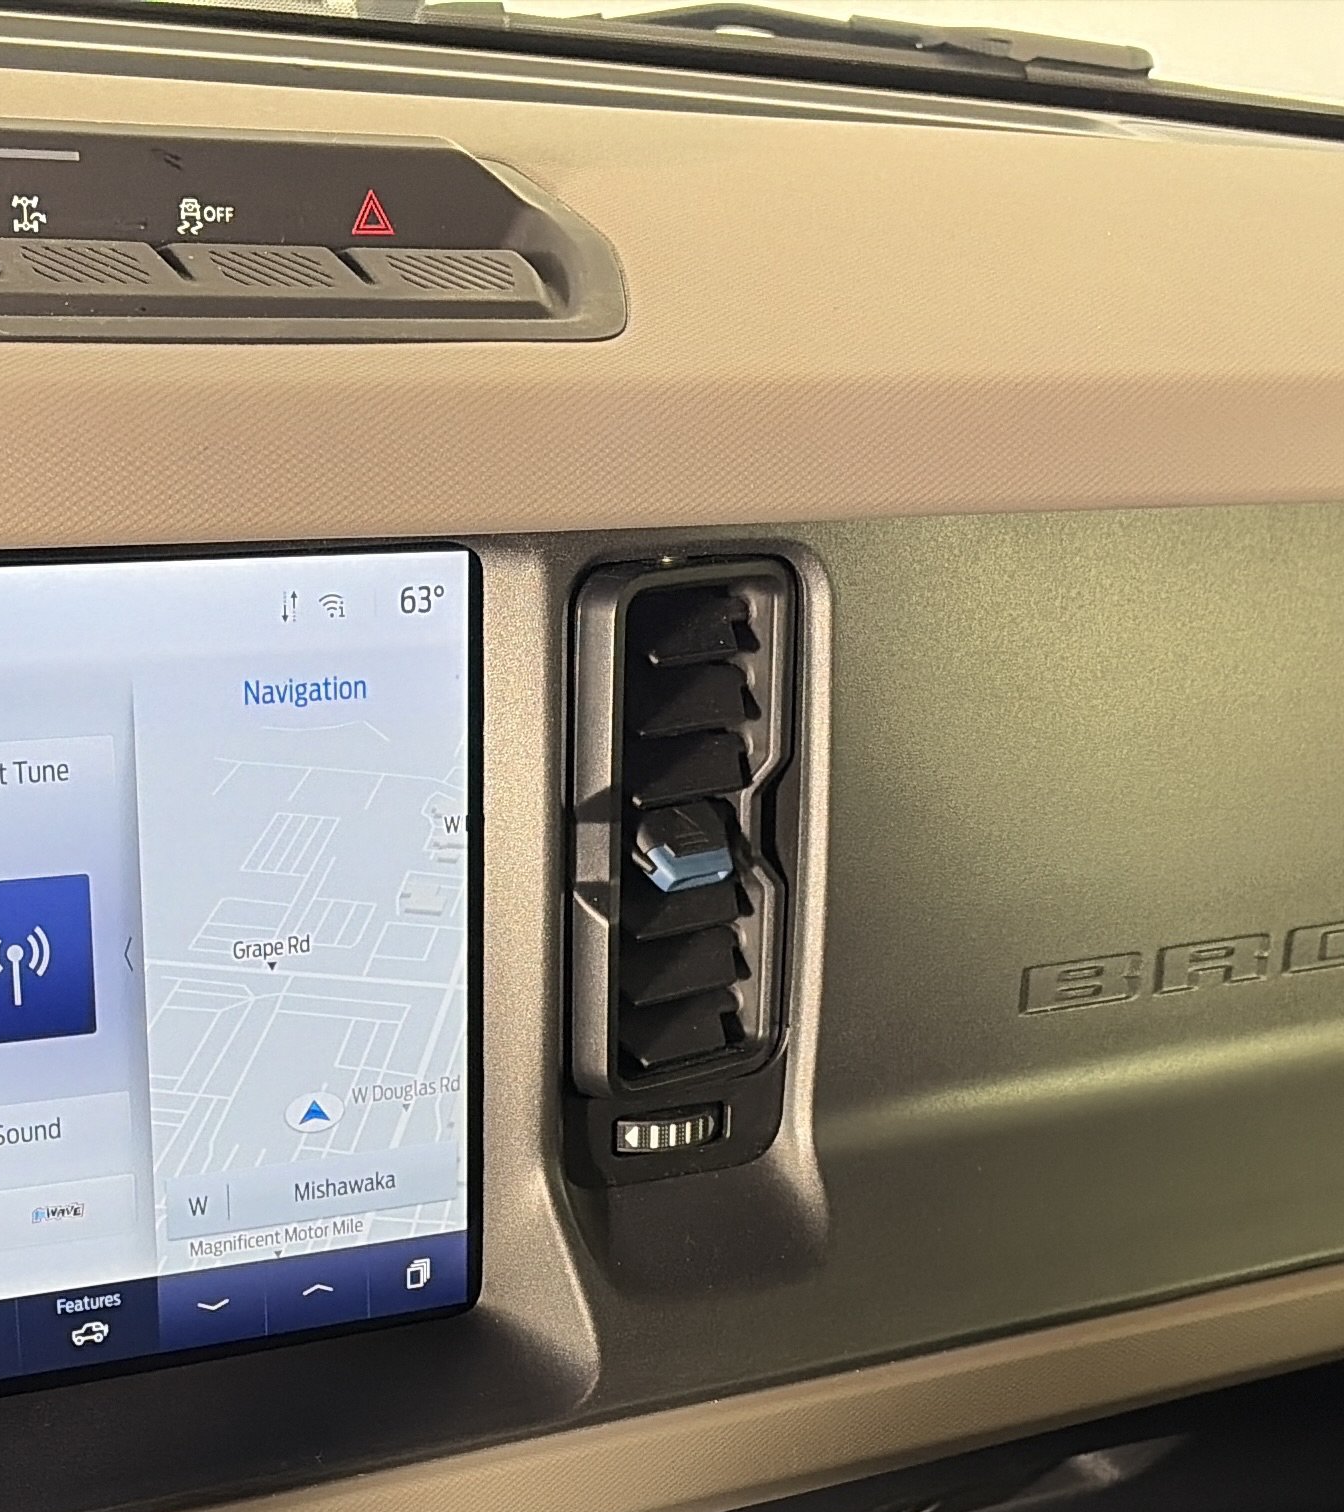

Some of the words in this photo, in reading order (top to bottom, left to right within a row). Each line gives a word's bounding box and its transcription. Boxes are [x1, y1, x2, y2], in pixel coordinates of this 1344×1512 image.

[204, 204, 235, 223] OFF
[400, 585, 446, 615] 63°
[243, 675, 368, 708] Navigation
[13, 757, 70, 786] Tune
[233, 936, 283, 961] Grape
[287, 934, 311, 956] Rd
[353, 1086, 369, 1103] W
[372, 1079, 436, 1107] Douglas
[438, 1074, 461, 1095] Rd
[294, 1171, 397, 1203] Mishawaka
[187, 1195, 208, 1217] W
[188, 1228, 281, 1259] Magnificent
[284, 1222, 329, 1246] Motor
[332, 1217, 365, 1238] Mile
[56, 1291, 122, 1315] Features
